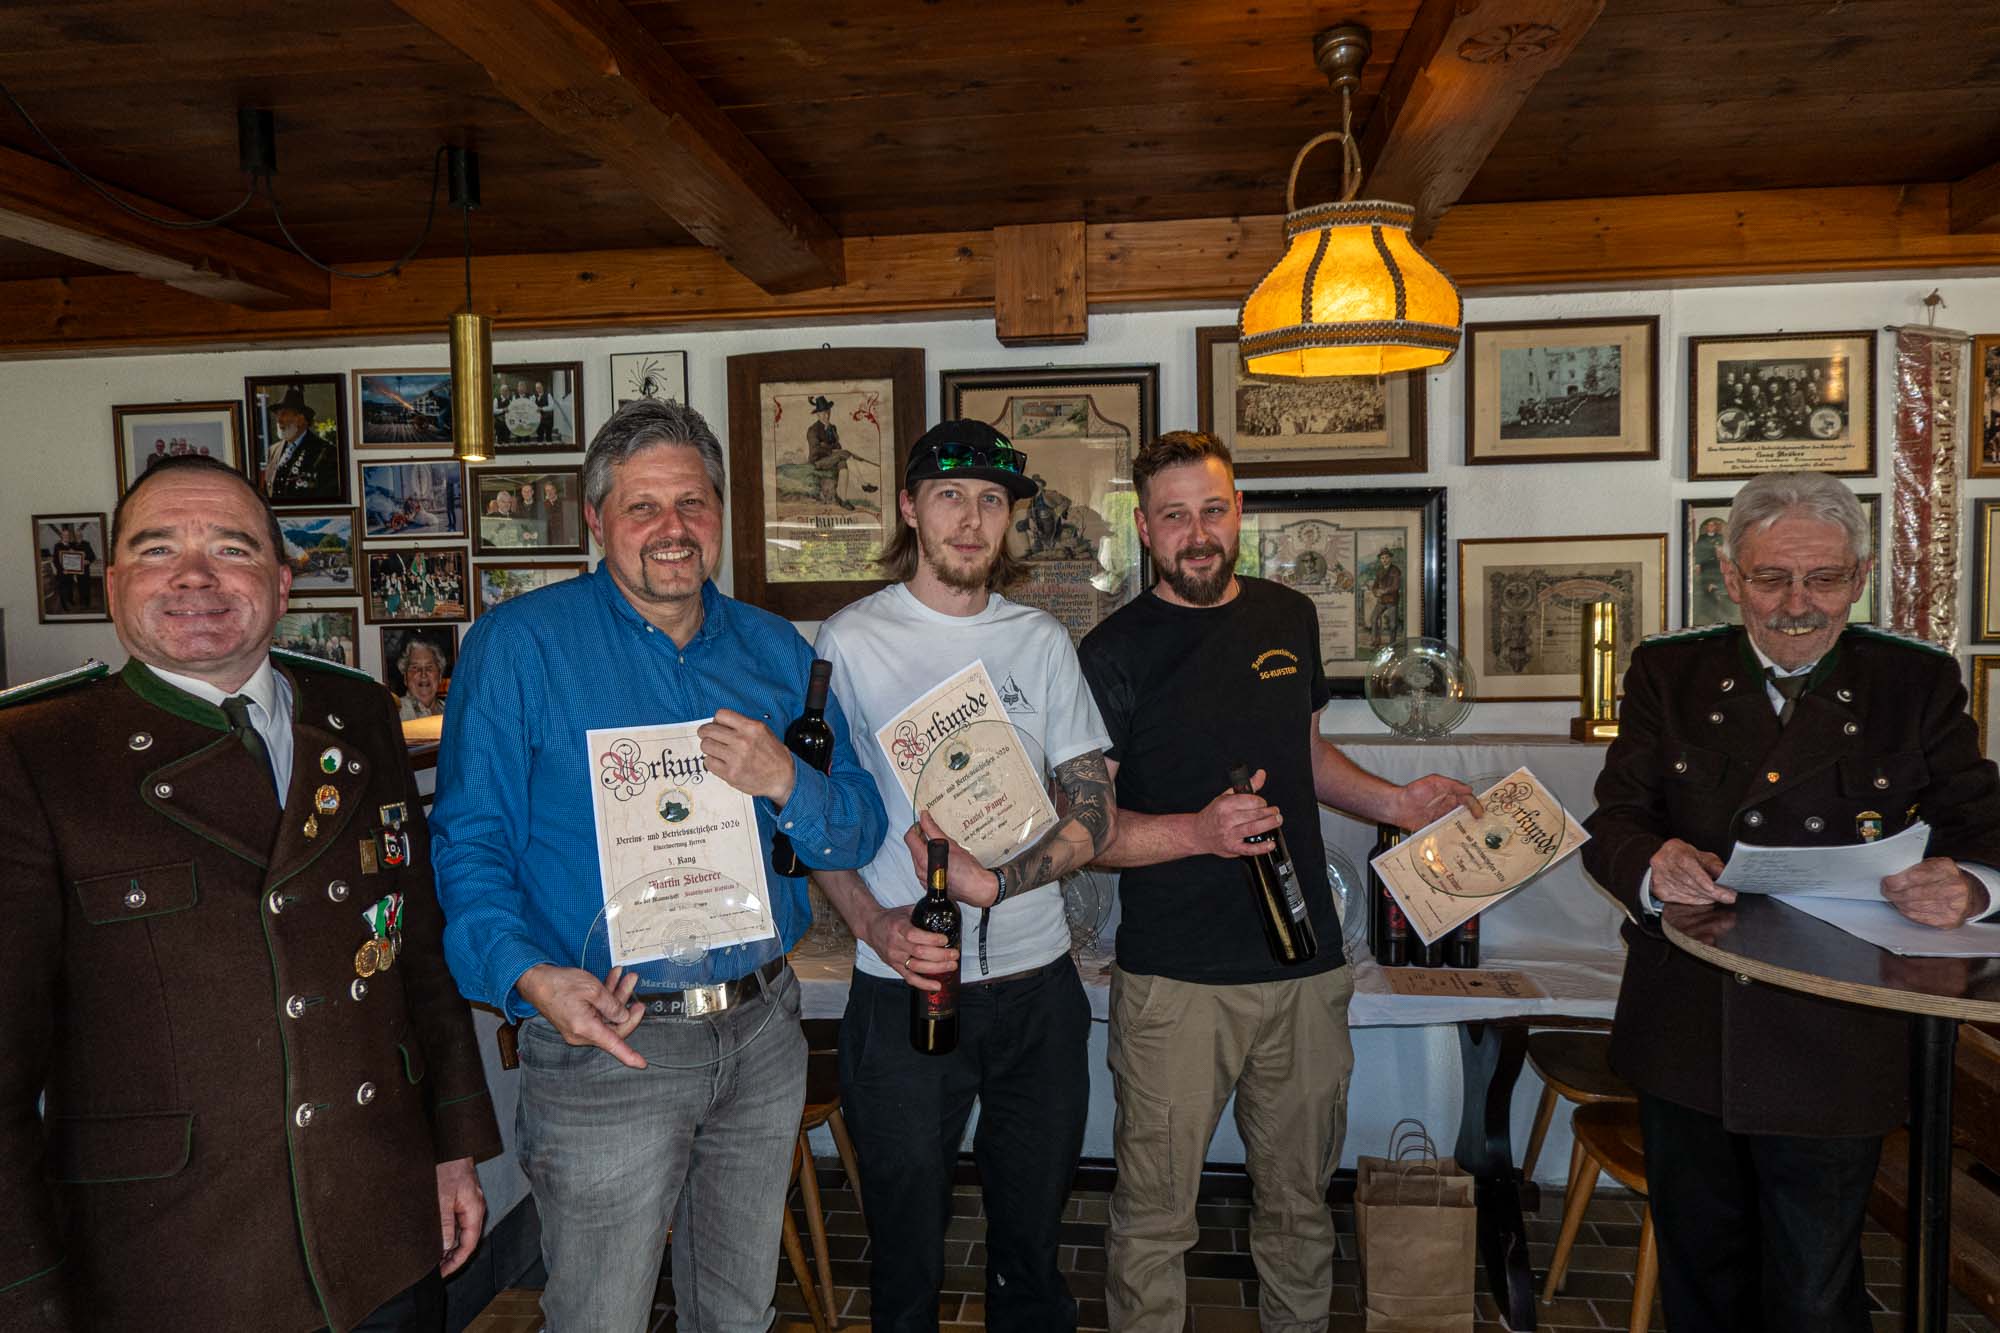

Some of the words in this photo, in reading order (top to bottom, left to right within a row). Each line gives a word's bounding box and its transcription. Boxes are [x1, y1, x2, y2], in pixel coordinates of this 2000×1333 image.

[892, 692, 988, 774] Urkunde
[600, 738, 708, 801] Urkun
[1486, 781, 1557, 854] Urkunde
[616, 835, 645, 846] Vereins-
[647, 832, 660, 841] und
[662, 824, 718, 839] Betriebsschießen
[720, 819, 740, 830] 2026
[677, 855, 696, 865] Rang
[648, 877, 680, 890] Martin
[683, 871, 722, 887] Sieberer
[640, 979, 677, 989] Martin
[654, 1000, 667, 1013] 3.
